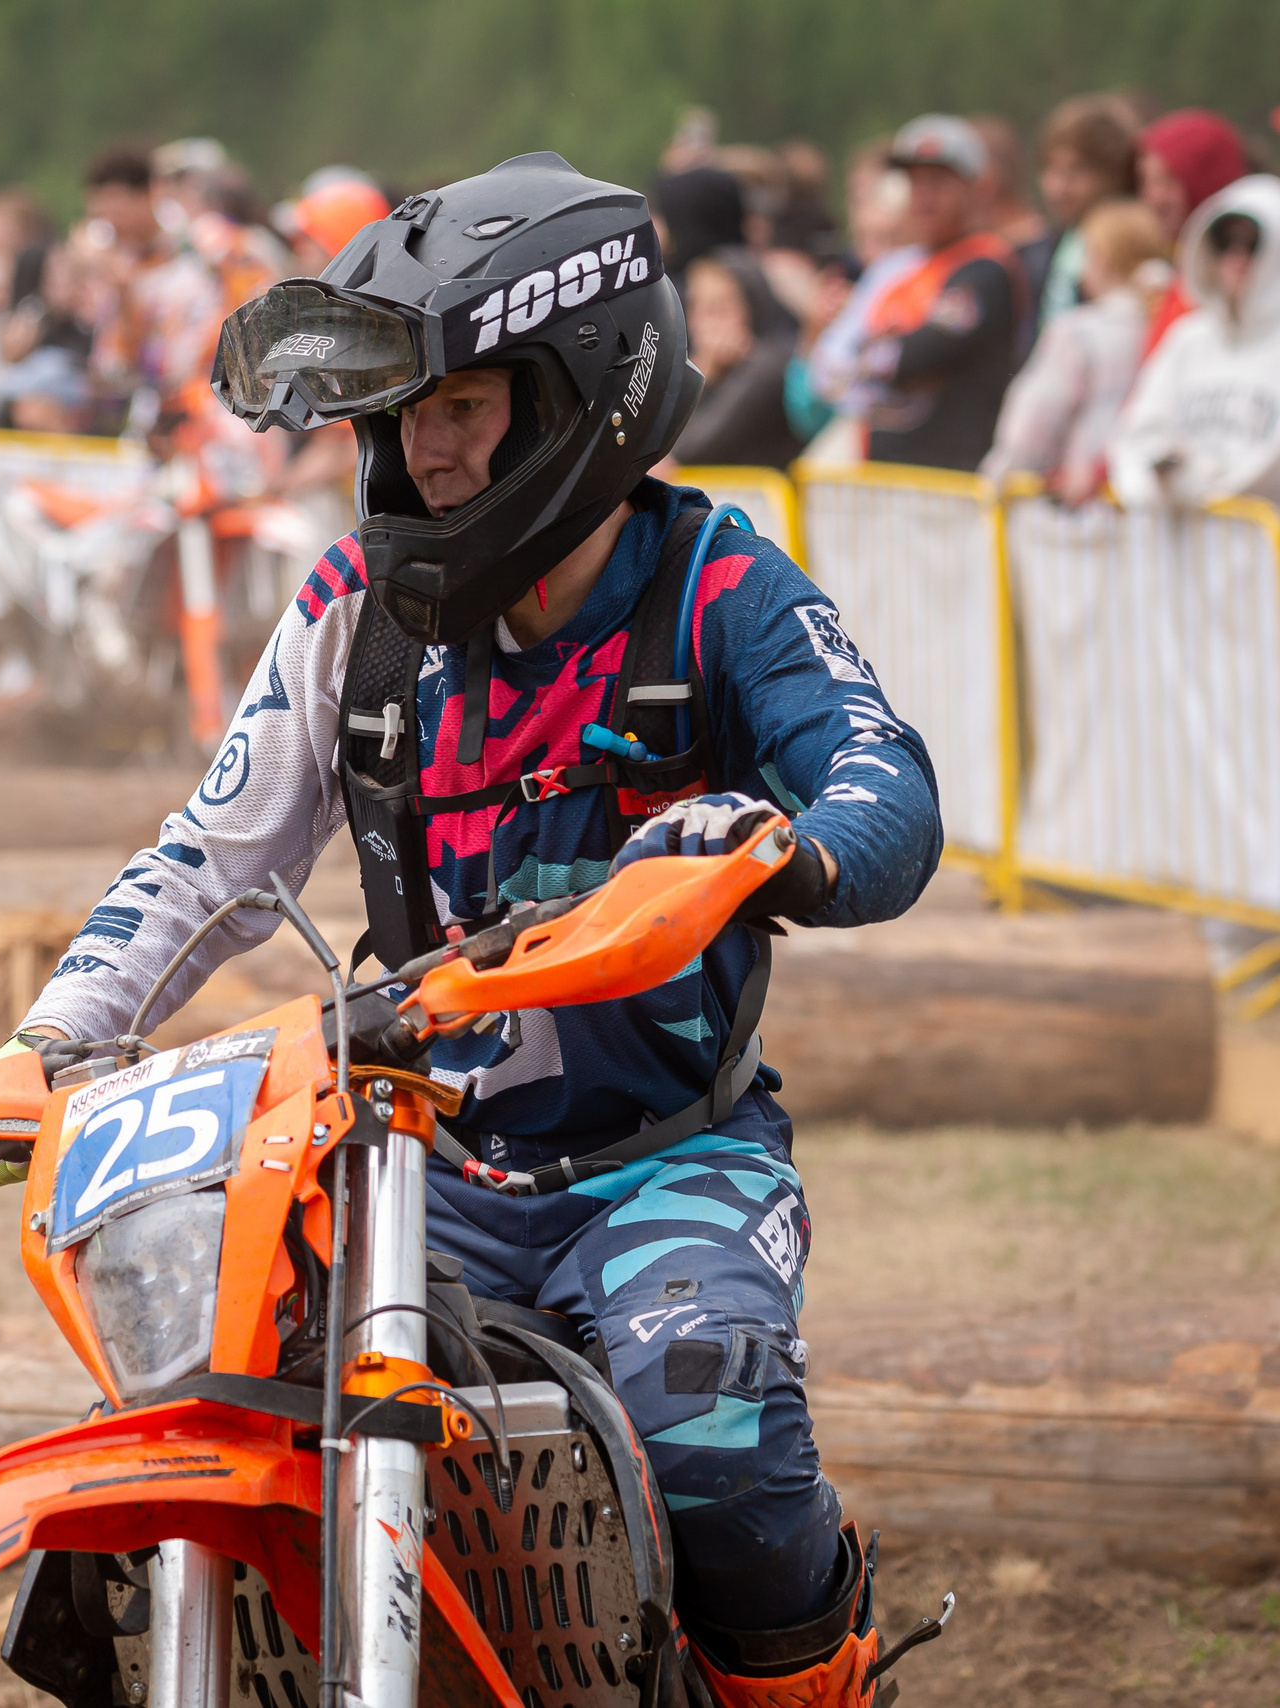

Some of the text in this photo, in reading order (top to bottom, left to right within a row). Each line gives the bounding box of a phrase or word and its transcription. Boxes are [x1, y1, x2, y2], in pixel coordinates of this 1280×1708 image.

[261, 333, 336, 363] HIZER
[469, 233, 650, 354] 100%
[623, 321, 660, 418] HIZER
[74, 1069, 226, 1219] 25
